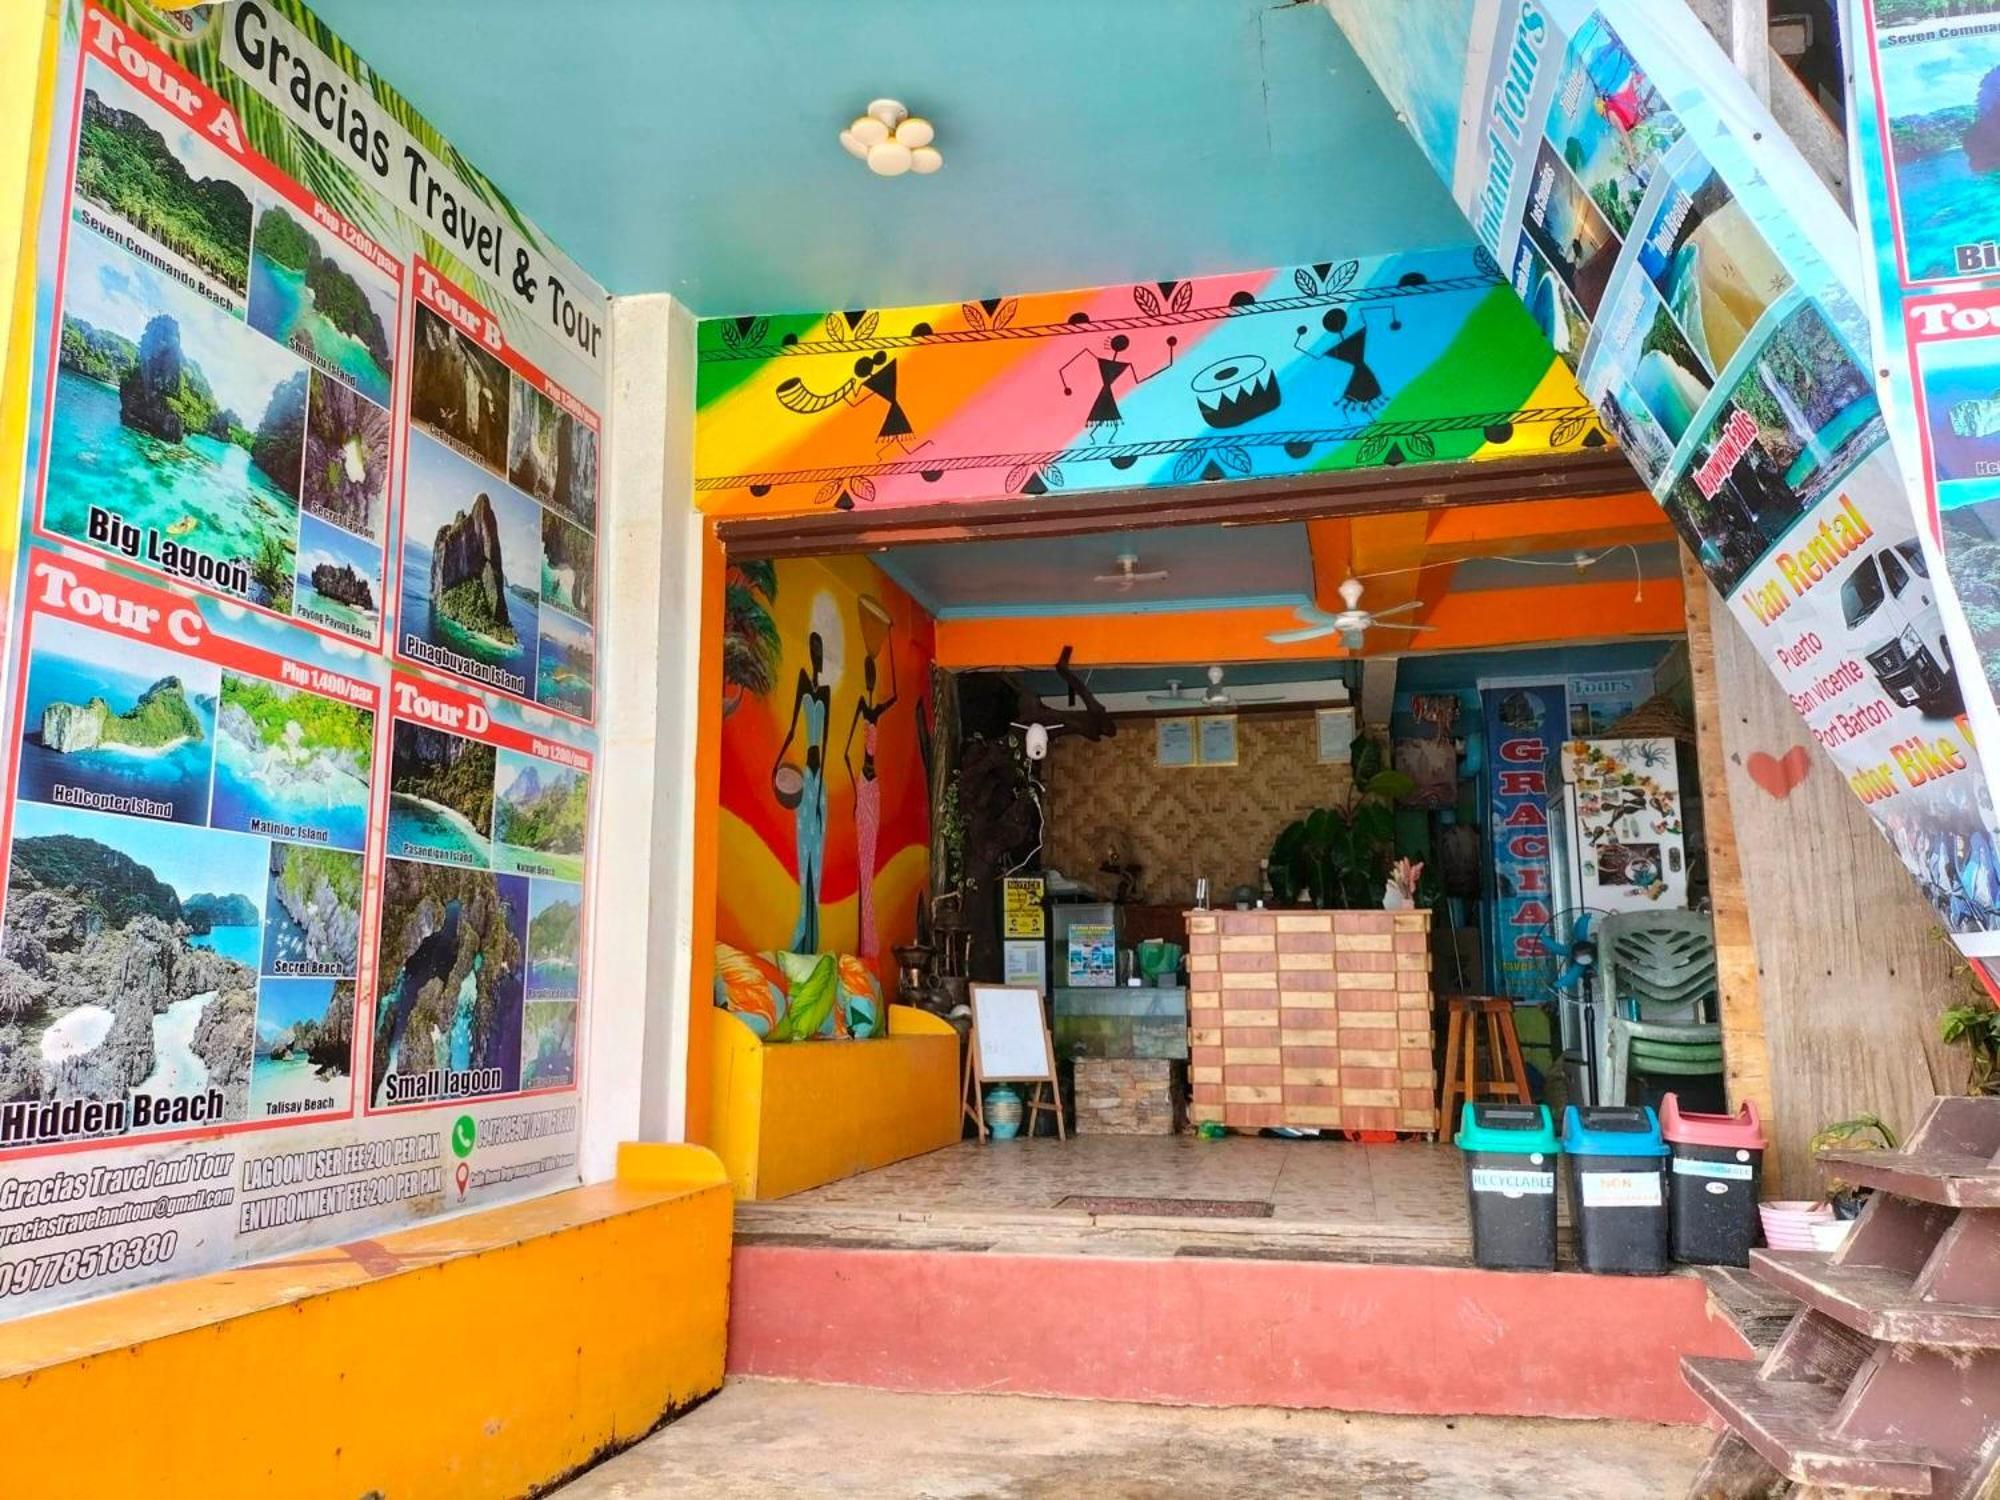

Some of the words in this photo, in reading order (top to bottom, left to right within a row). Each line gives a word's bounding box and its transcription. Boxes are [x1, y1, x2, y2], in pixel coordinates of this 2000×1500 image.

[1887, 31, 1936, 46] Seven
[88, 8, 203, 116] Tour
[207, 107, 245, 154] A
[1491, 2, 1546, 142] Tours
[233, 0, 389, 178] Gracias
[404, 148, 503, 276] Travel
[512, 247, 537, 304] &
[547, 275, 603, 359] Tour
[81, 208, 124, 245] Seven
[125, 235, 197, 290] Commando
[197, 281, 235, 314] Beach
[418, 266, 481, 334] Tour
[484, 316, 503, 350] B
[1909, 302, 2000, 336] To
[288, 338, 327, 369] Shimizu
[328, 361, 356, 387] Island
[88, 505, 142, 557] Big
[148, 530, 250, 595] Lagoon
[1742, 579, 1791, 627] Van
[1775, 492, 1875, 597] Rental
[34, 562, 161, 635] Tour
[167, 611, 202, 648] C
[297, 603, 324, 625] Payong
[325, 614, 350, 634] Payong
[351, 622, 373, 641] Beach
[281, 659, 310, 687] Php
[405, 632, 491, 681] Pinagbuyatan
[490, 663, 526, 694] Island
[1777, 631, 1823, 673] Puerto
[395, 682, 465, 728] Tour
[465, 703, 489, 734] D
[1789, 690, 1819, 716] San
[1811, 660, 1865, 702] vicente
[1812, 720, 1848, 748] Port
[1835, 698, 1894, 739] Barton
[1889, 735, 1968, 788] Bike
[53, 783, 131, 814] Helicopter
[130, 798, 173, 819] Island
[297, 825, 329, 842] Island
[274, 959, 310, 975] Secret
[311, 961, 344, 974] Beach
[265, 1100, 302, 1117] Talisay
[303, 1096, 335, 1112] Beach
[386, 1072, 443, 1101] Small
[444, 1067, 502, 1097] lagoon
[0, 1097, 126, 1141] Hidden
[131, 1088, 224, 1128] Beach
[0, 1171, 89, 1212] Gracias
[89, 1159, 154, 1198] Travel
[154, 1155, 193, 1187] and
[192, 1152, 235, 1182] Tour
[242, 1152, 305, 1193] LAGOON
[306, 1147, 344, 1182] USER
[393, 1135, 417, 1166] PER
[417, 1131, 442, 1162] PAX
[1474, 1174, 1553, 1189] RECYCLABLE
[239, 1184, 348, 1235] ENVIRONMENT
[395, 1169, 418, 1202] PER
[419, 1166, 443, 1195] PAX
[0, 1230, 178, 1299] 09778518380
